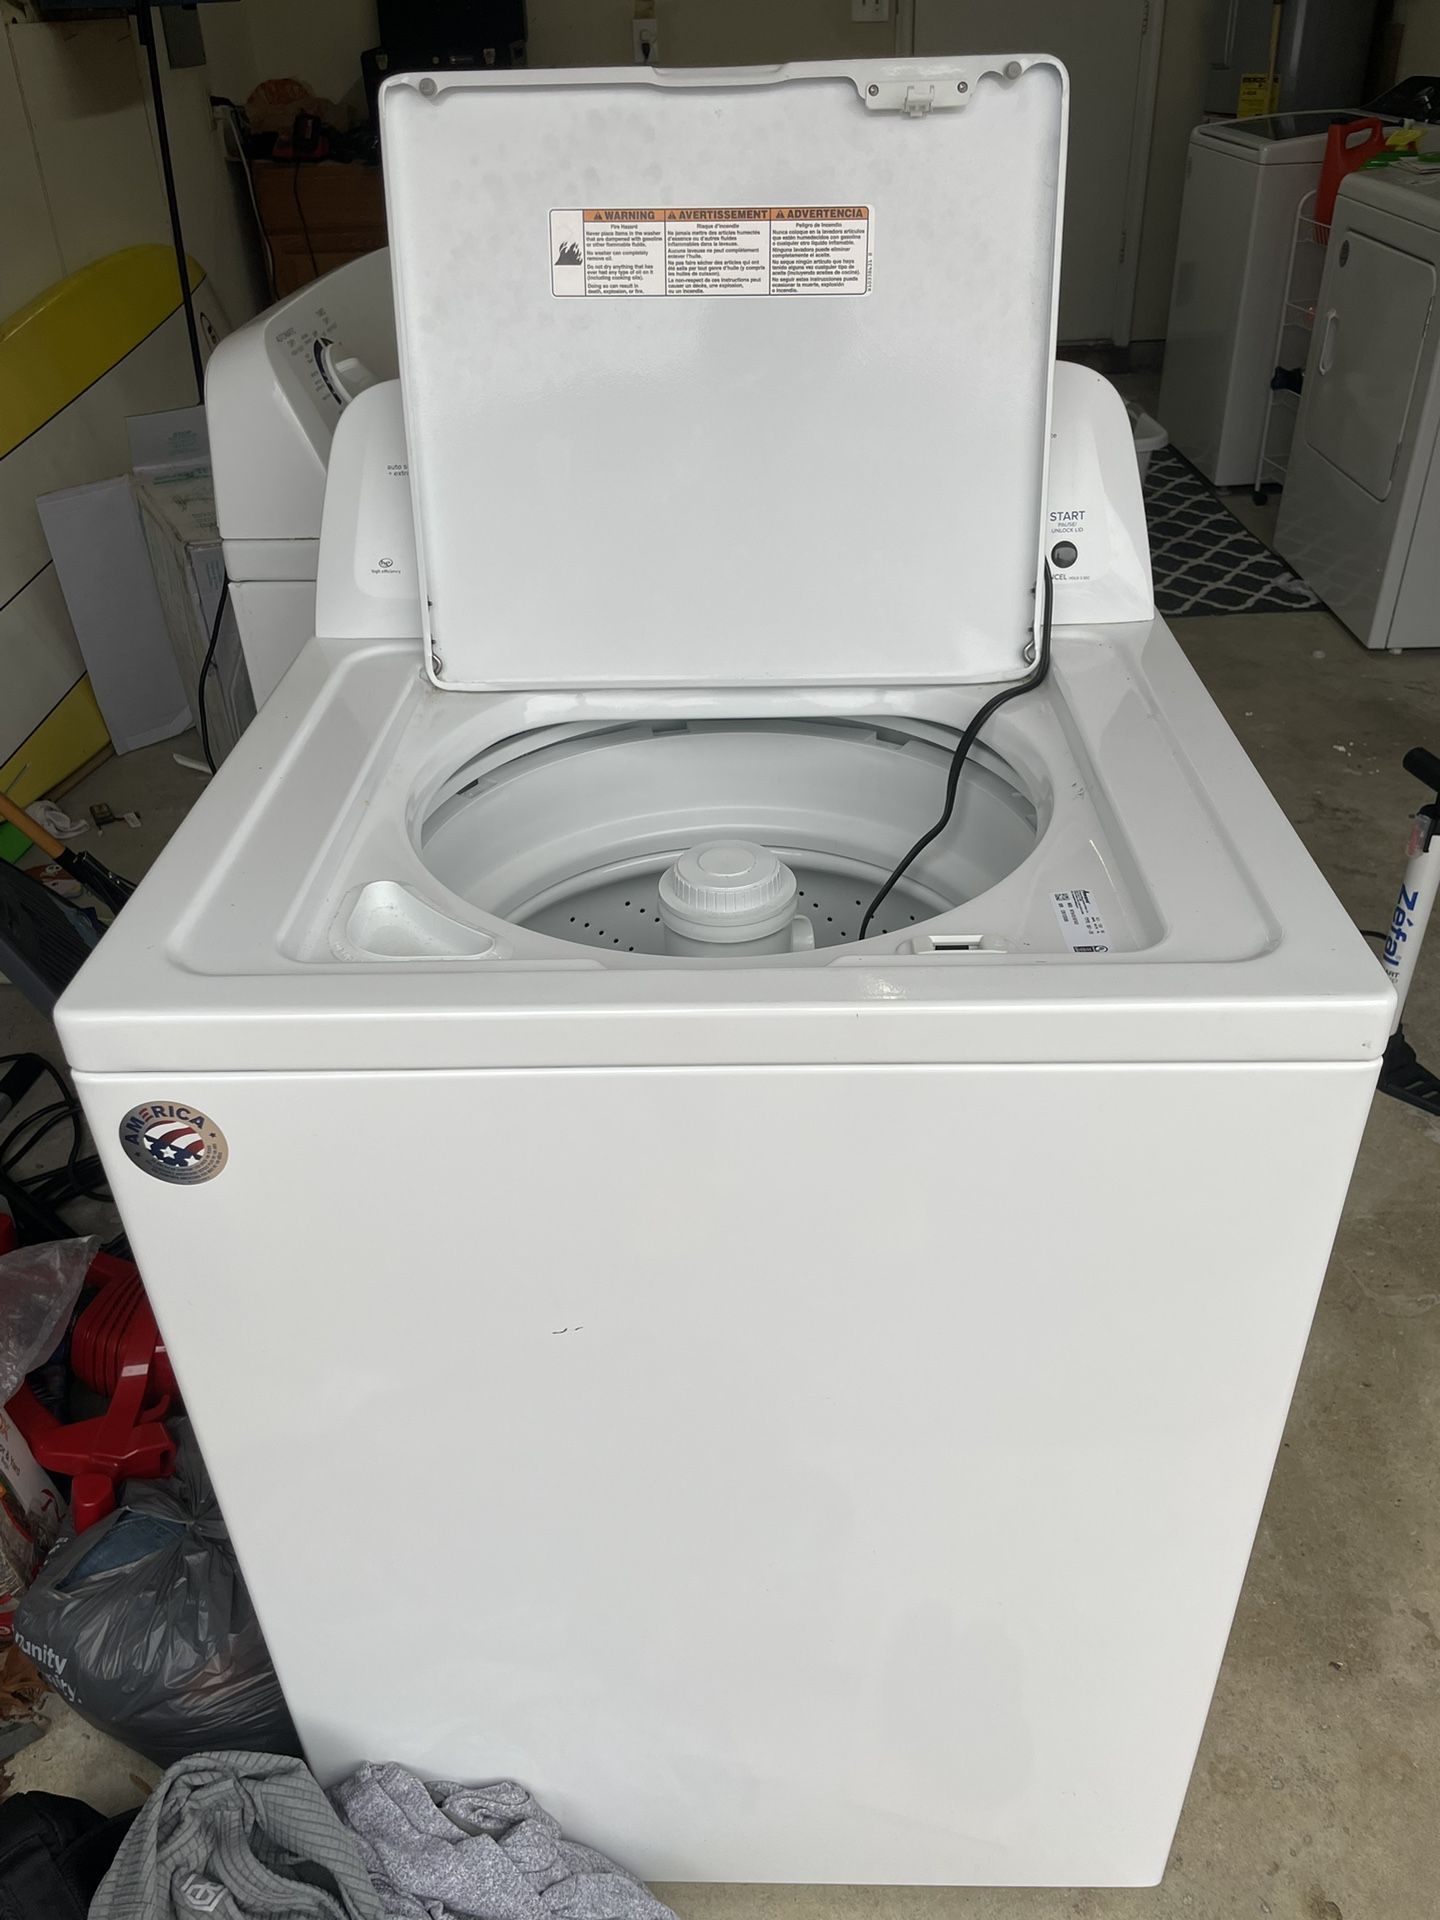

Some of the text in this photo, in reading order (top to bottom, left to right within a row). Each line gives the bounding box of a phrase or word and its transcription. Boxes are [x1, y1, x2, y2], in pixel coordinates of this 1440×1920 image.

[605, 212, 654, 220] WARNING
[679, 211, 767, 219] AVERTISSEMENT
[787, 209, 862, 218] ADVERTENCIA
[1050, 511, 1085, 521] START
[1383, 884, 1418, 966] Zéfal
[124, 1106, 205, 1146] AMERICA
